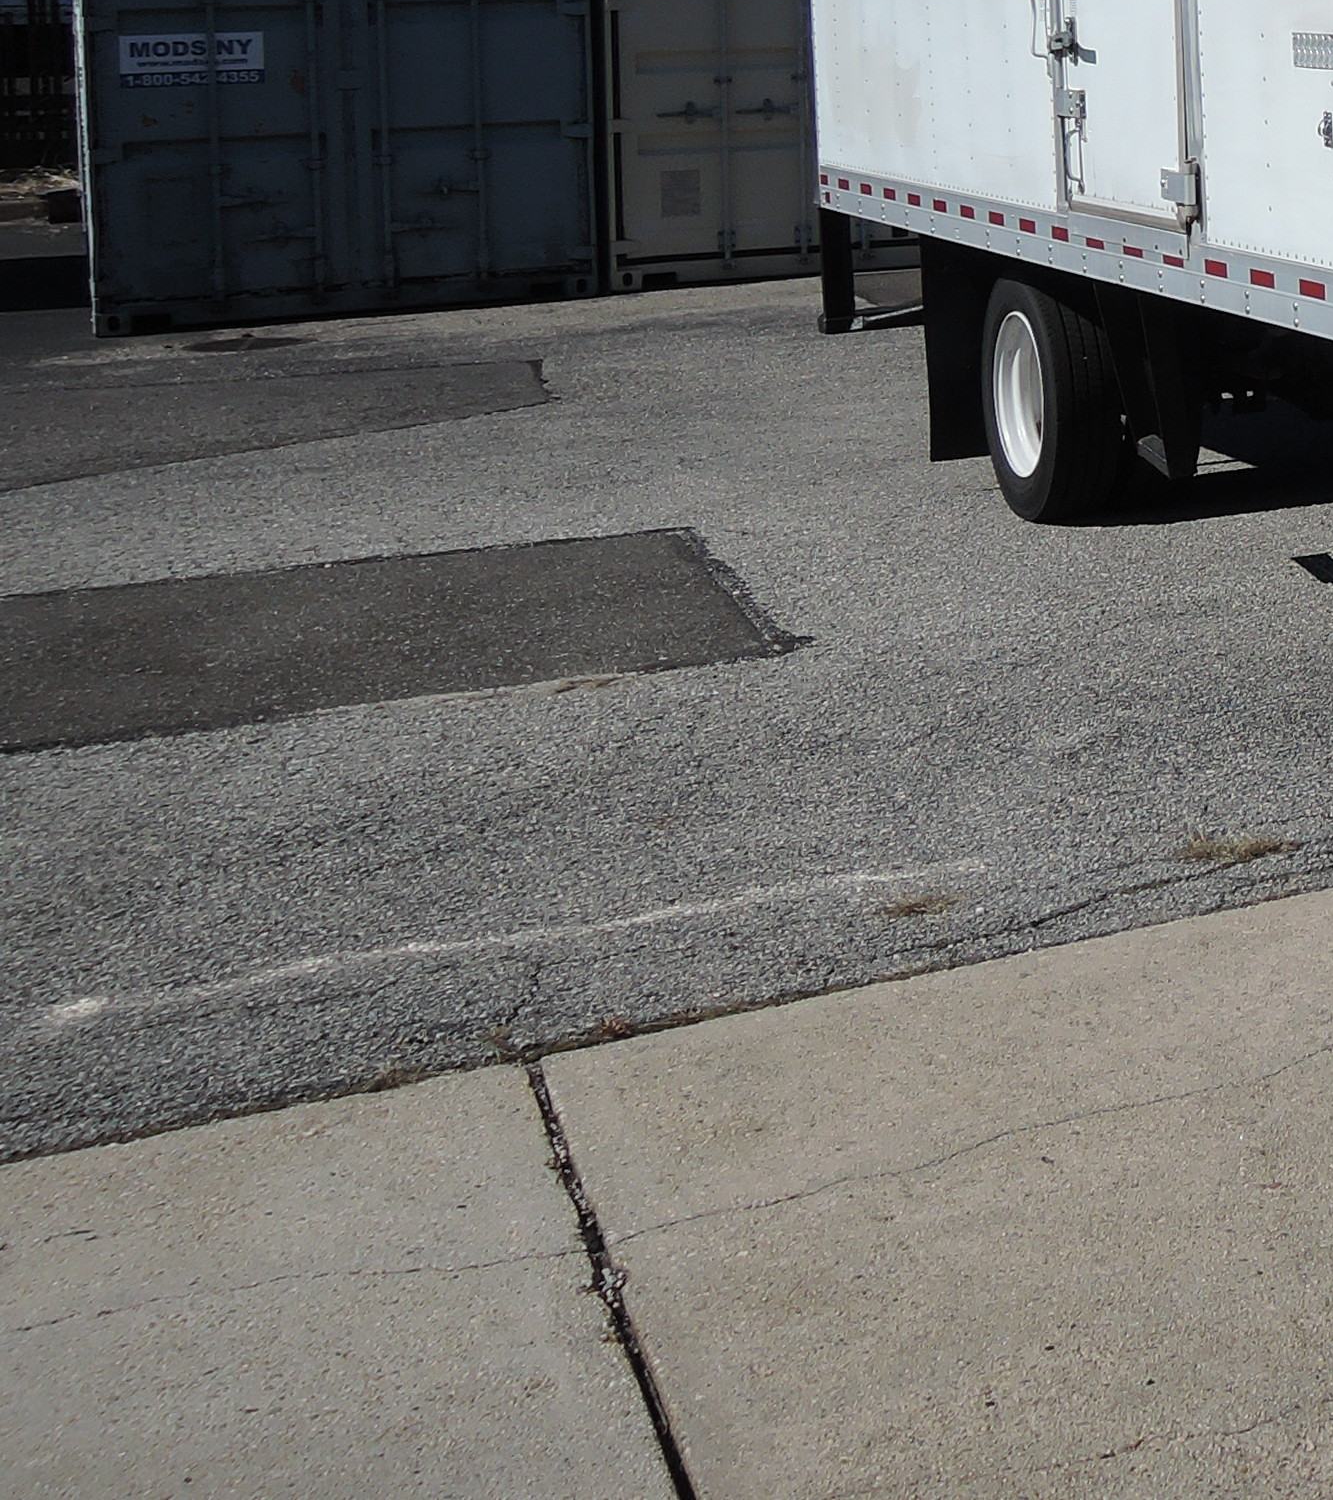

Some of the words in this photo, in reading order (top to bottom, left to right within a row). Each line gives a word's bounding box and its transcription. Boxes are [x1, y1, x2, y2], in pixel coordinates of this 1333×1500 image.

[129, 40, 206, 58] MODS
[216, 39, 253, 55] NY
[125, 71, 259, 87] 1-800-5424355
